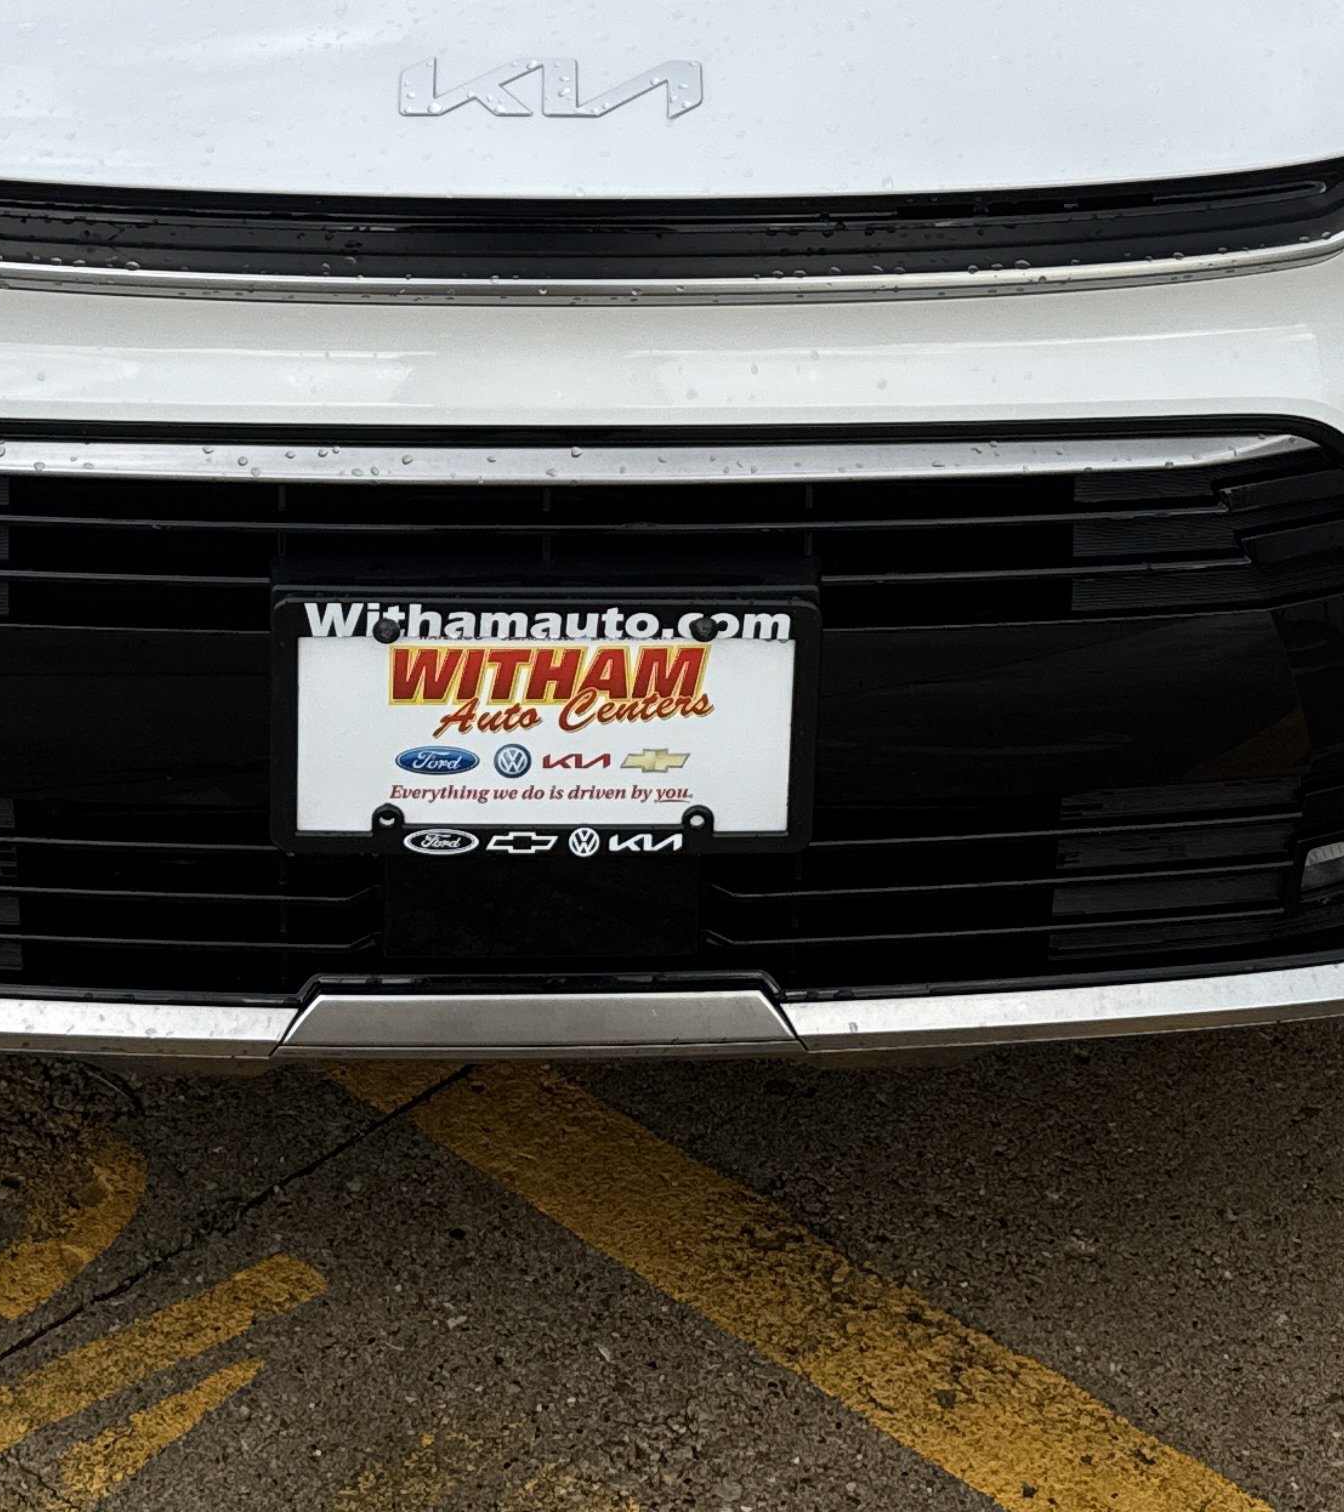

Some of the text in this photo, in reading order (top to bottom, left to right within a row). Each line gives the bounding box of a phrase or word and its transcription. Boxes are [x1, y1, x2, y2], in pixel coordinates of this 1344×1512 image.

[398, 56, 704, 120] KIA
[304, 602, 792, 641] Withamauto.com
[389, 644, 712, 705] WITHAM
[432, 688, 715, 738] Auto Centers
[389, 784, 488, 804] Everything
[493, 789, 517, 800] we
[522, 784, 545, 800] do
[549, 784, 564, 800] is
[568, 784, 626, 800] driven
[631, 784, 654, 803] by
